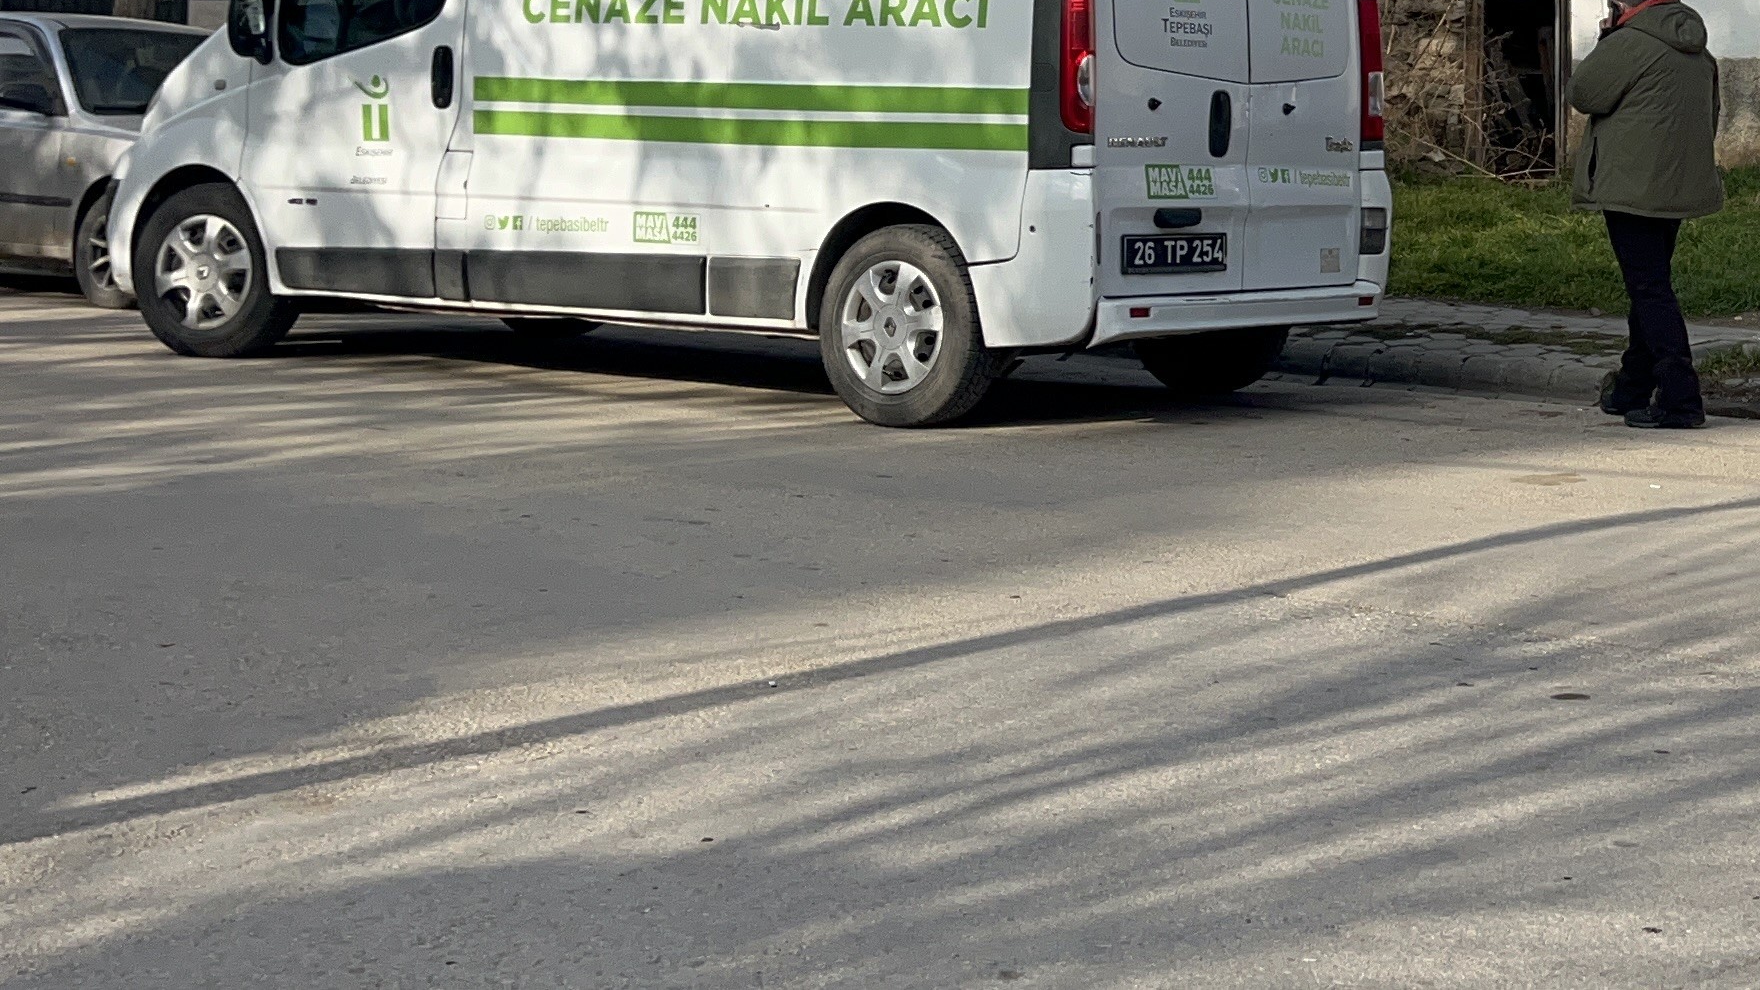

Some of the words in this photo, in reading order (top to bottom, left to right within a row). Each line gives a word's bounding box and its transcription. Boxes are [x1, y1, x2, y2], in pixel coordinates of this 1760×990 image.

[1187, 168, 1212, 183] 444
[1188, 183, 1215, 196] 4426
[672, 216, 697, 230] 444
[672, 230, 697, 242] 4426
[1134, 241, 1156, 266] 26
[1163, 239, 1189, 264] TP
[1192, 238, 1223, 263] 254
